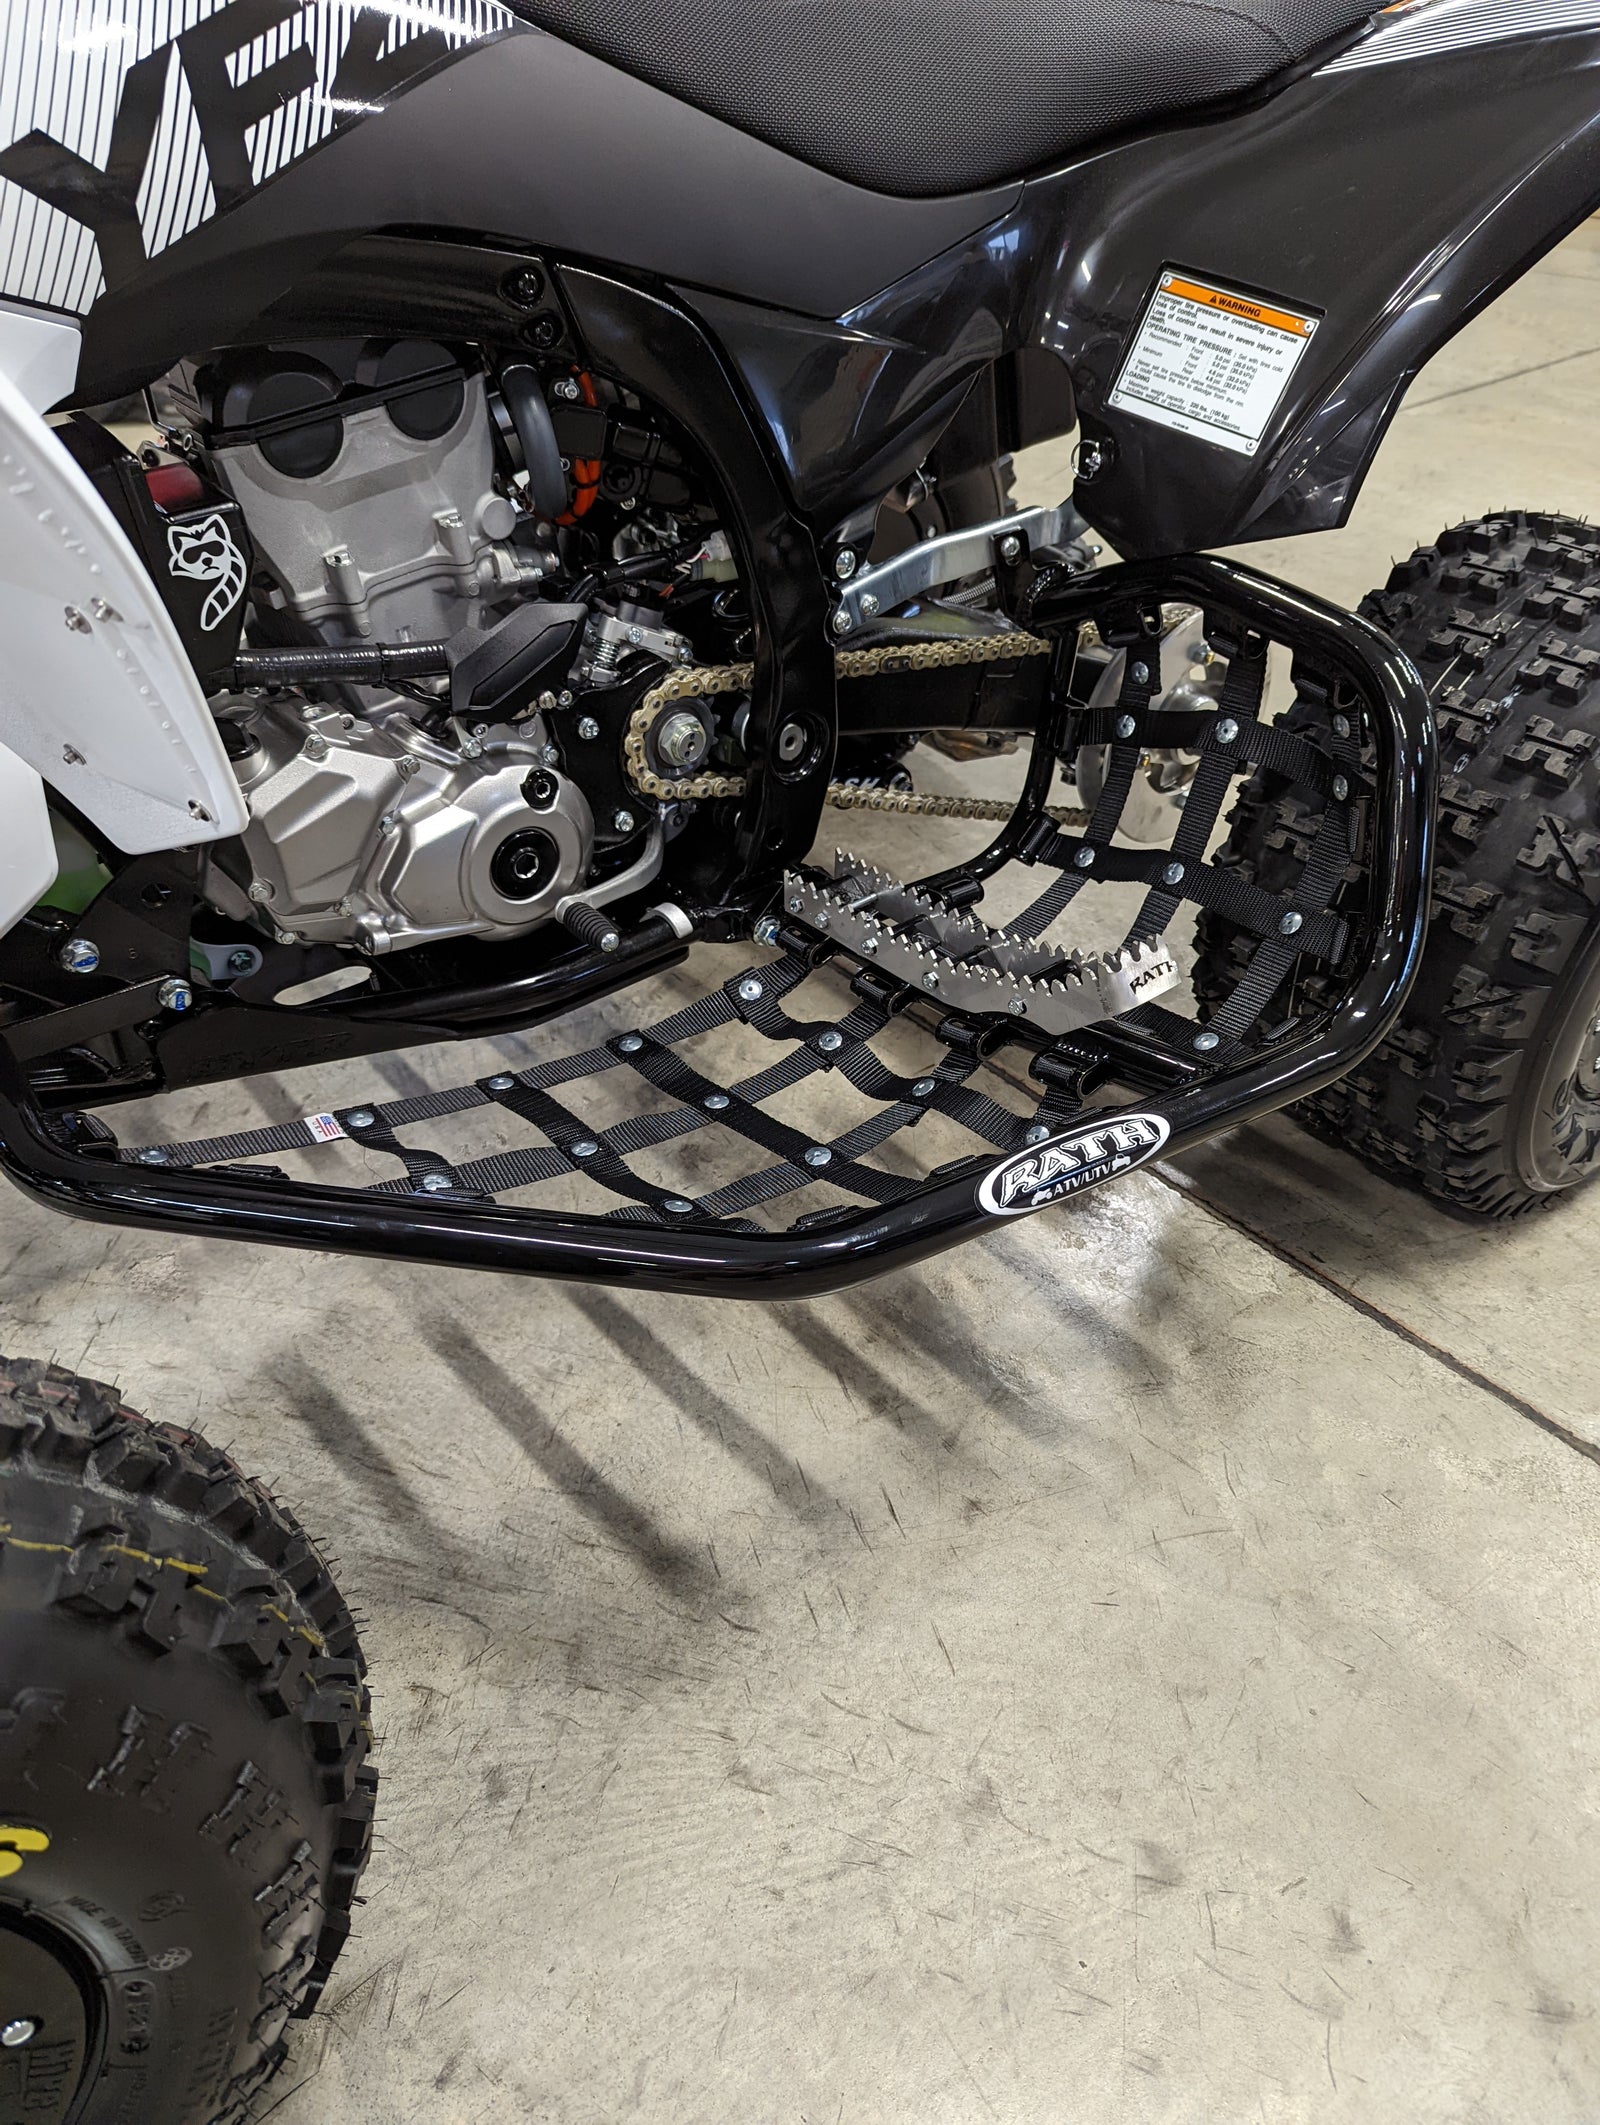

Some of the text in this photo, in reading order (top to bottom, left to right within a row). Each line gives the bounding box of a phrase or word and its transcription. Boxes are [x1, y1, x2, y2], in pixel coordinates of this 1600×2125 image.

[1148, 314, 1166, 324] death.
[1155, 300, 1167, 308] loss
[1176, 307, 1198, 318] control.
[1156, 293, 1183, 308] Improper
[1184, 302, 1194, 310] tire
[1195, 306, 1221, 320] pressure
[1230, 317, 1265, 334] overloading
[1266, 329, 1278, 337] can
[1279, 333, 1298, 344] cause
[1217, 297, 1262, 317] WARNING
[1145, 321, 1283, 373] OPERATING TIRE PRESSURE Set with tires cold
[1151, 308, 1166, 317] Loss
[1175, 315, 1196, 327] control
[1196, 323, 1208, 331] can
[1209, 326, 1226, 337] result
[1235, 335, 1255, 346] severe
[1255, 341, 1274, 354] injury
[1125, 369, 1150, 383] LOADING
[999, 1118, 1160, 1208] RATH
[1053, 1161, 1113, 1197] ATV/UTV
